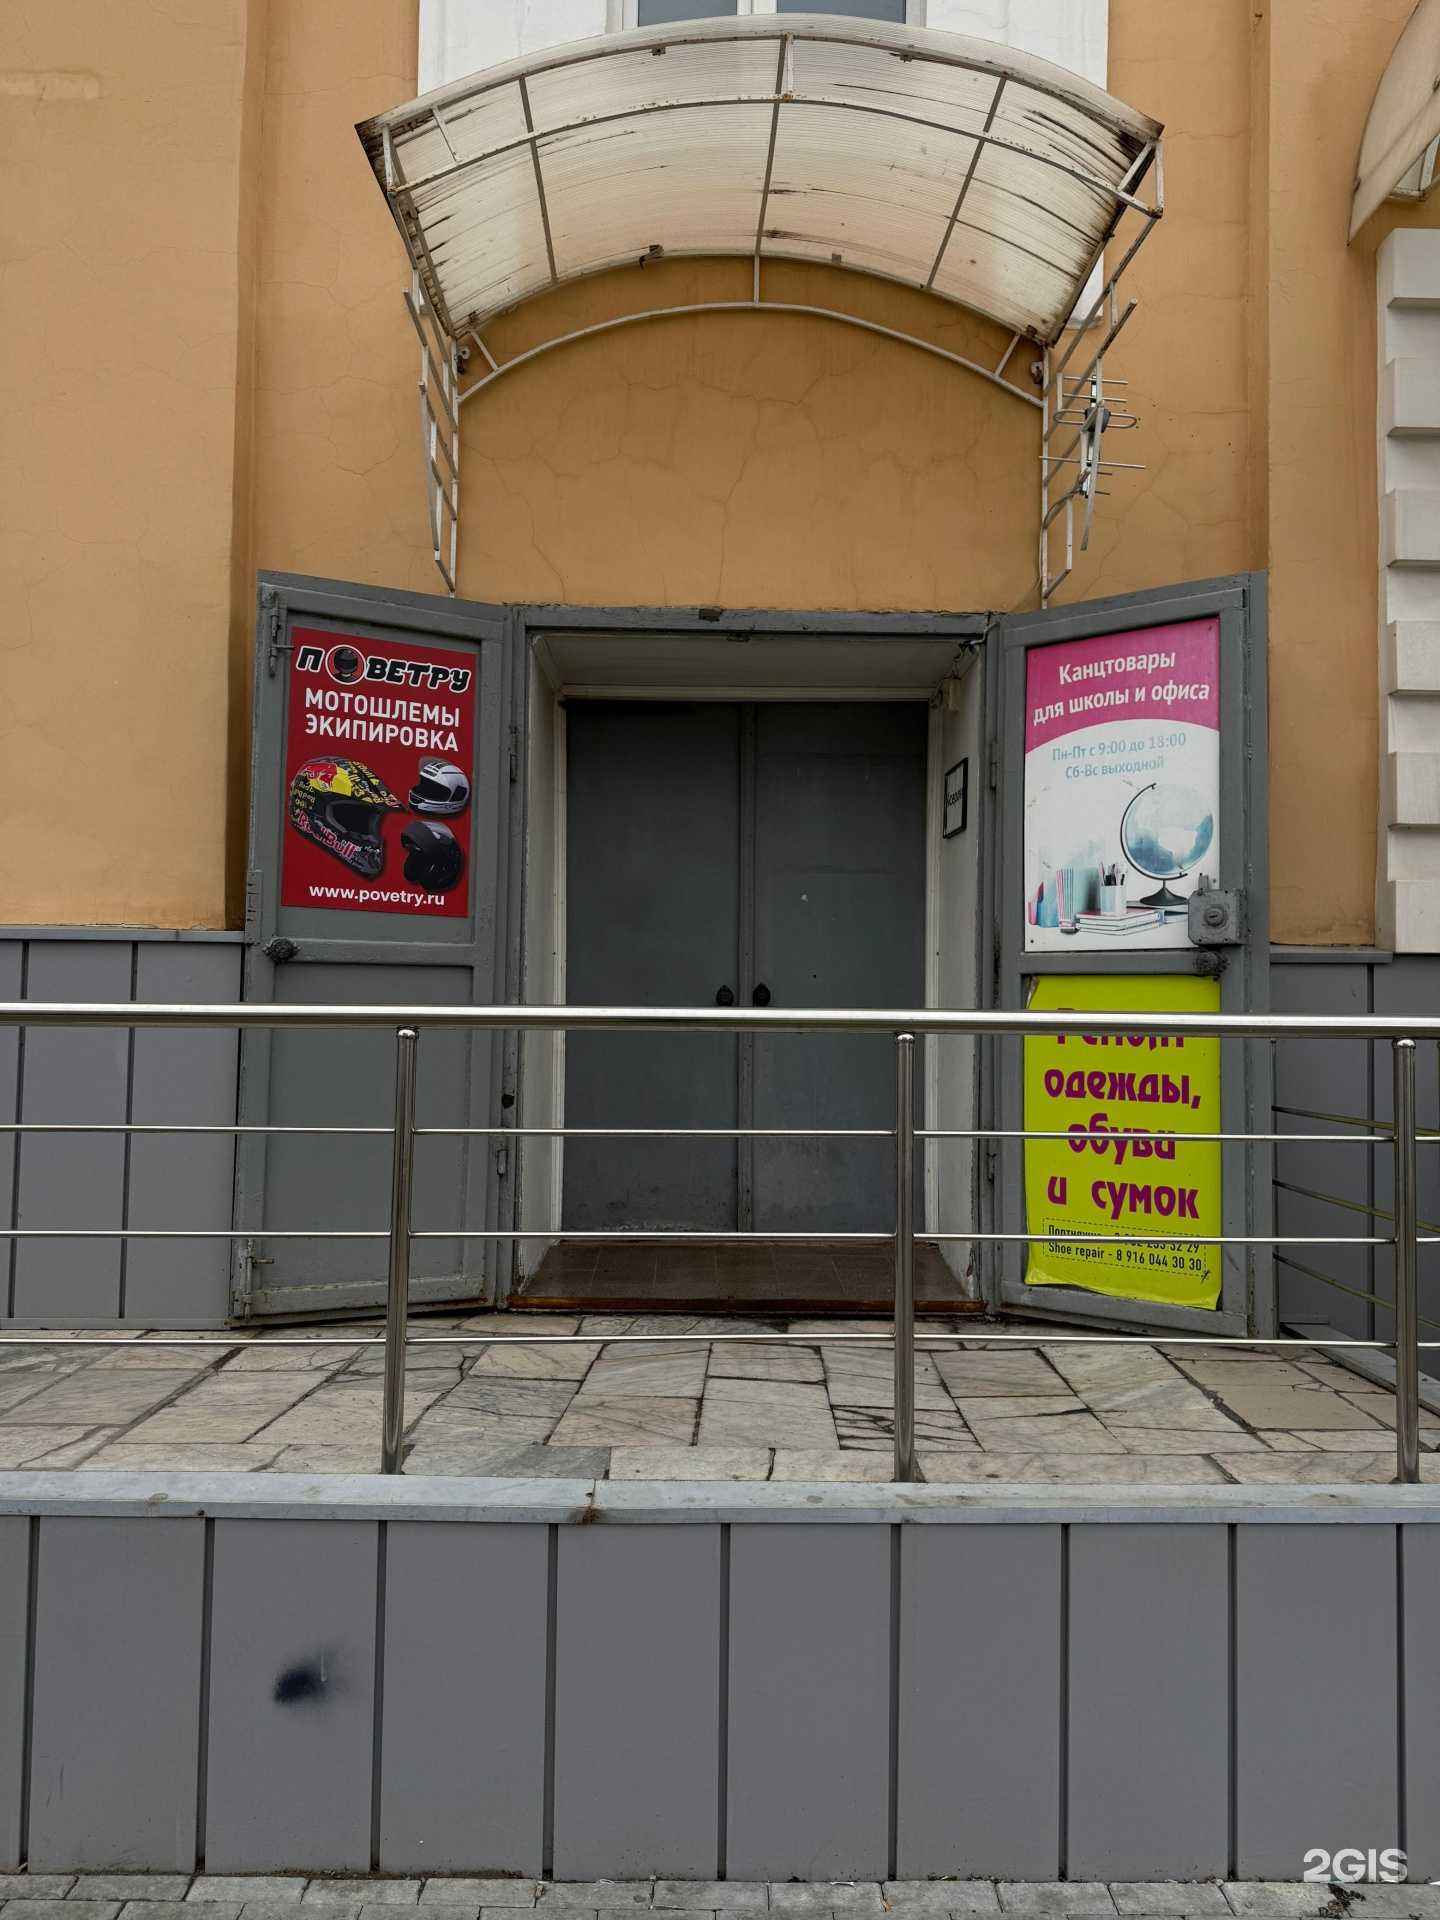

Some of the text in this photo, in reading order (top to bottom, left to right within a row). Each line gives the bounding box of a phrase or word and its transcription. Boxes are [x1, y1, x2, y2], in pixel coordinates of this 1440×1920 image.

[1059, 652, 1176, 685] Канцтовары
[305, 687, 460, 728] МОТОШЛЕМЫ
[1033, 680, 1211, 726] для школы и офиса
[305, 713, 459, 752] ЭКИПИРОВКА
[1052, 747, 1087, 761] Пн-Пт
[1098, 740, 1126, 755] 9:00
[1128, 740, 1145, 752] до
[1065, 756, 1165, 779] Сб-Вс выходной
[309, 886, 445, 907] www.povetry.ru
[1044, 1068, 1201, 1109] одежды,
[1068, 1112, 1176, 1165] обуви
[1047, 1175, 1200, 1220] и сумок
[1048, 1241, 1072, 1255] Shoe
[1075, 1247, 1104, 1259] repair
[1116, 1249, 1122, 1261] 8
[1126, 1250, 1145, 1264] 916
[1149, 1253, 1168, 1267] 044
[1172, 1256, 1185, 1269] 30
[1189, 1258, 1202, 1271] 30
